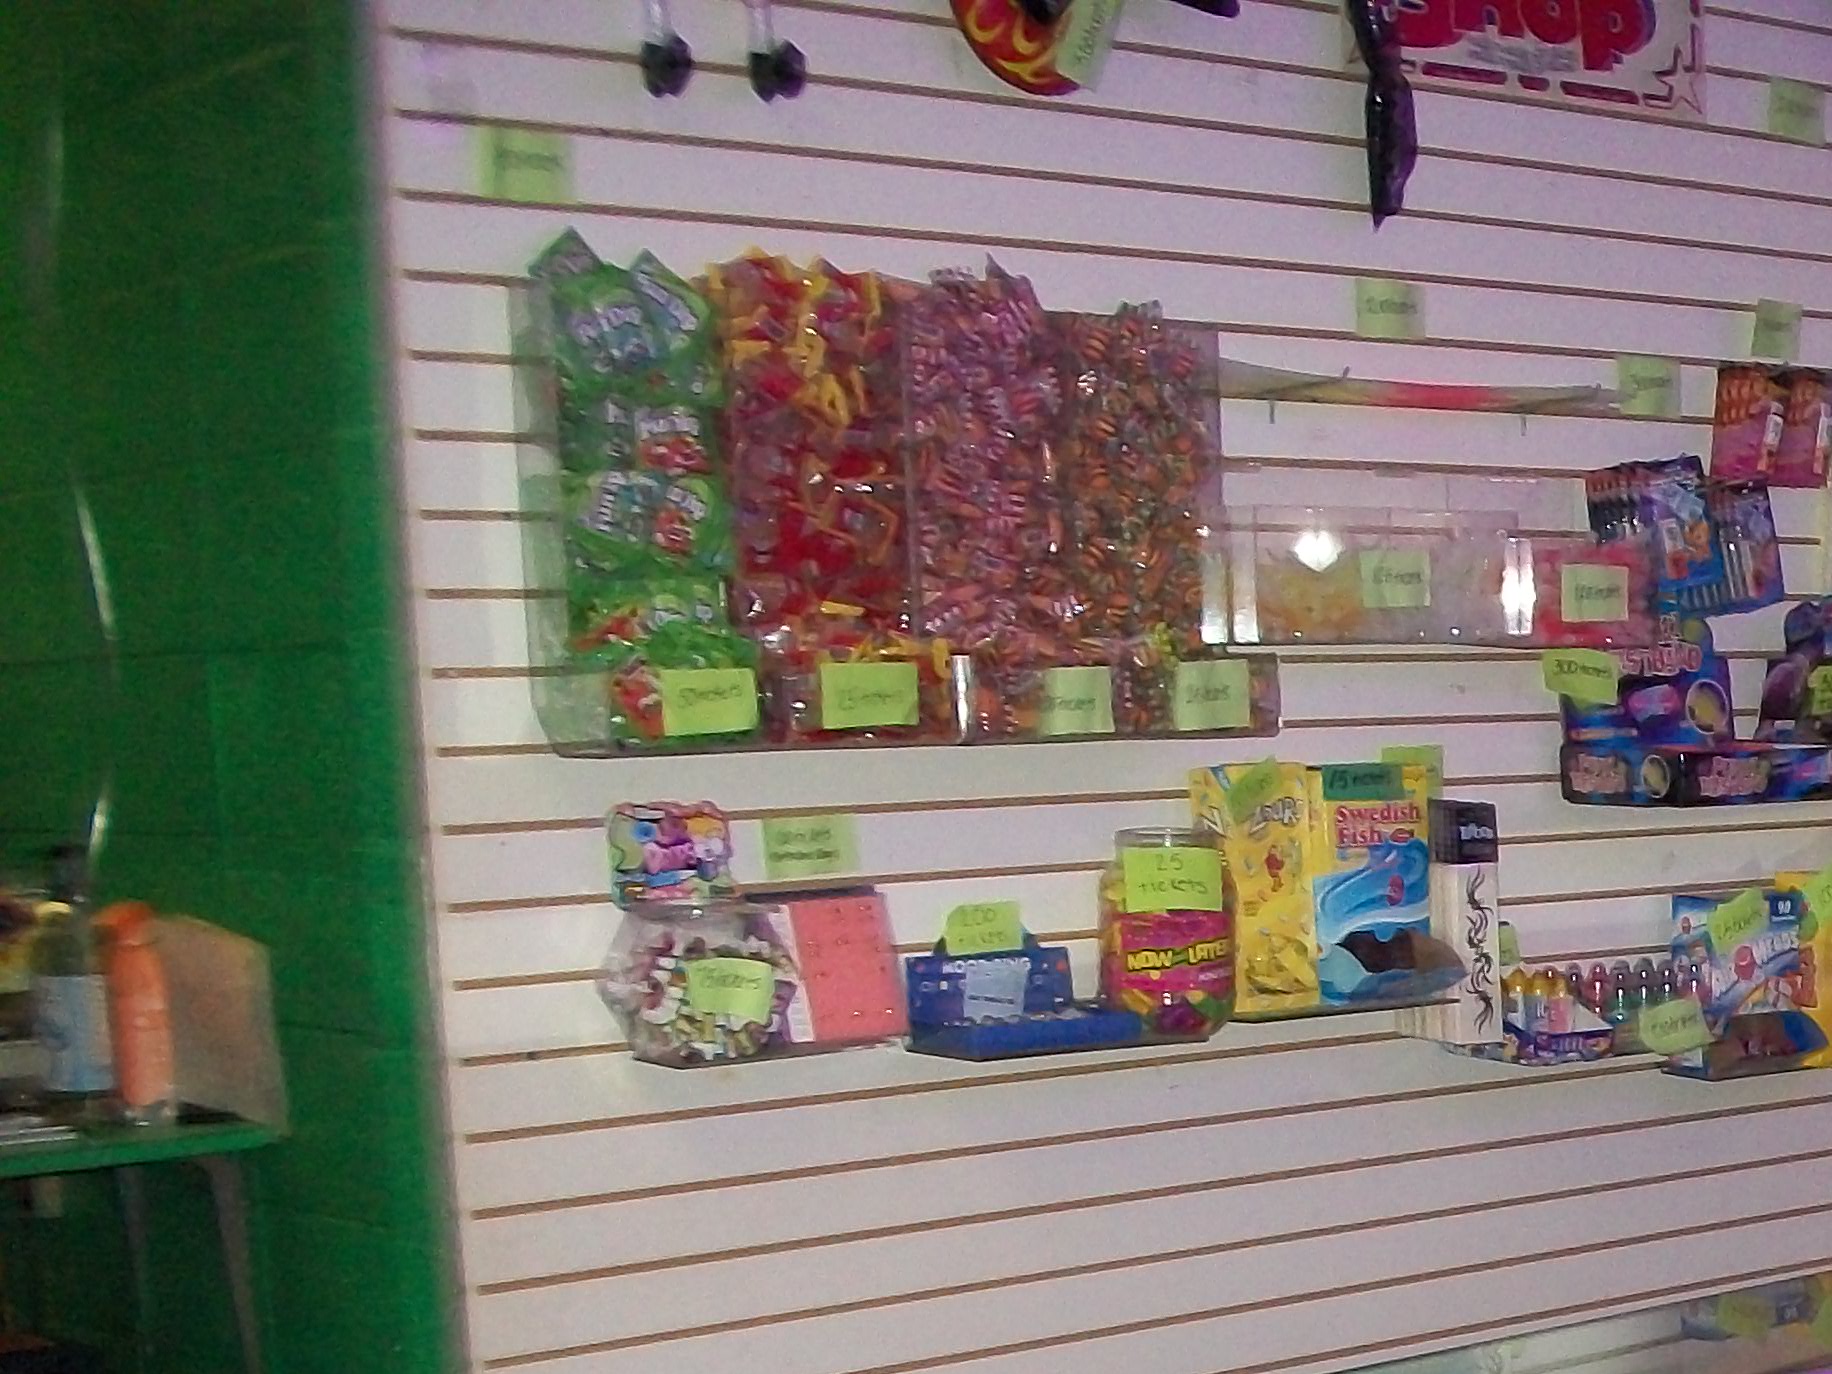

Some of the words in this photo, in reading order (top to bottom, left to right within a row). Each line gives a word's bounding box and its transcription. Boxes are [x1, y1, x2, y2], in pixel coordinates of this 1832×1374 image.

[1336, 804, 1420, 827] Swedish
[1337, 826, 1382, 848] Fish
[1157, 853, 1183, 871] 25
[1127, 948, 1172, 972] NOW
